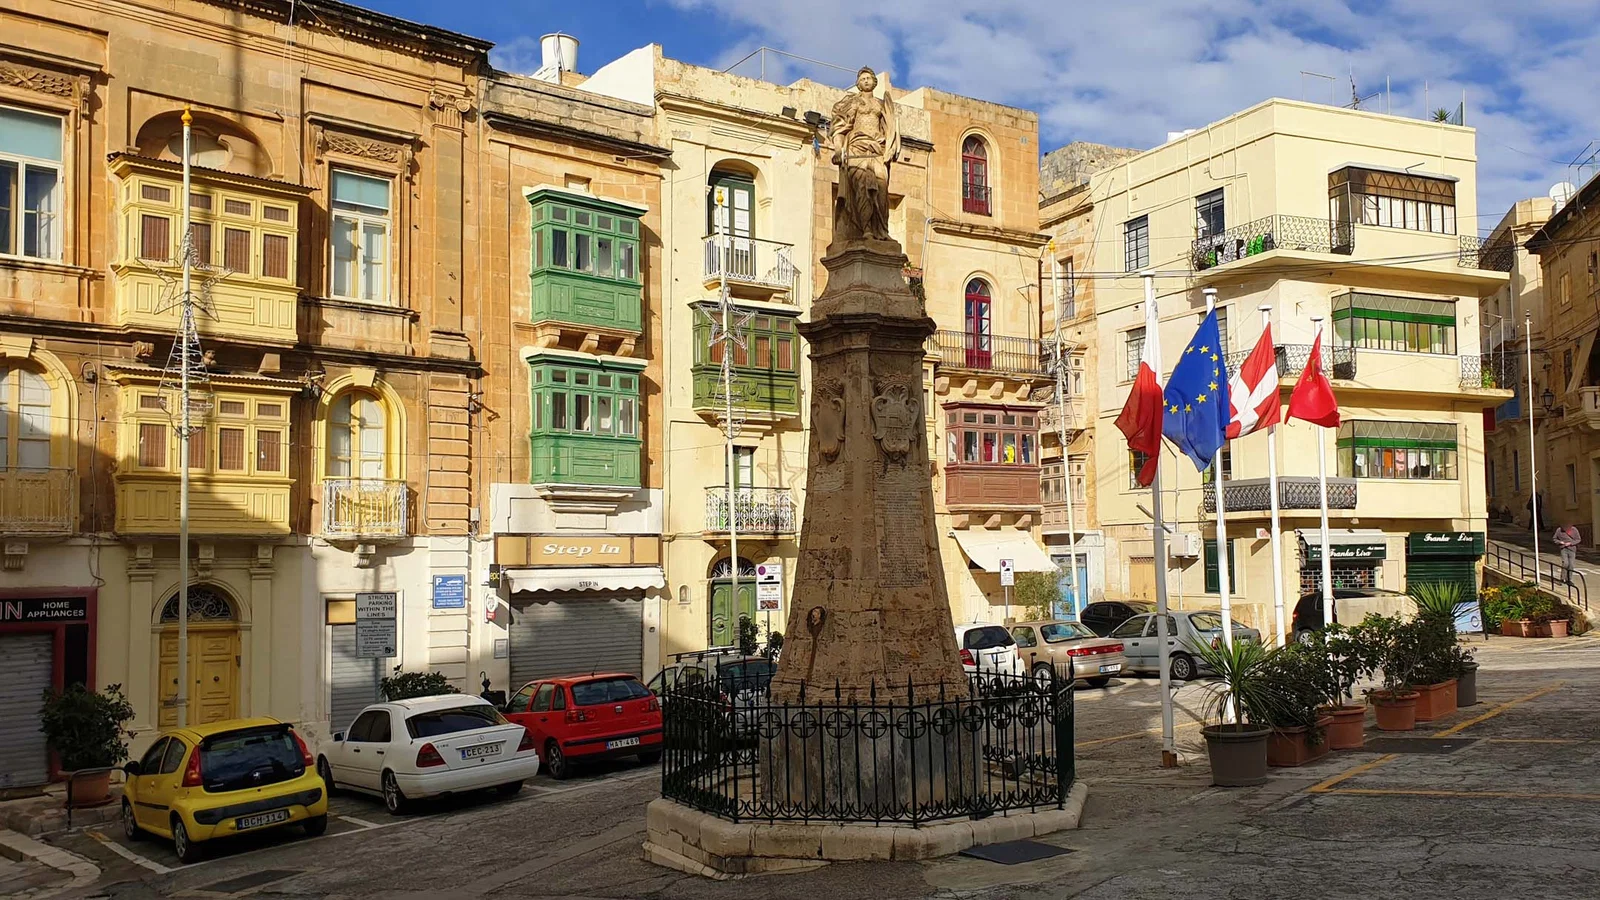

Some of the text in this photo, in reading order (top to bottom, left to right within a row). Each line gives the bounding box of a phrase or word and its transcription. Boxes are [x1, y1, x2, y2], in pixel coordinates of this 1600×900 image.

[543, 543, 620, 558] Step In
[436, 577, 443, 586] P
[43, 601, 70, 609] HOME
[27, 610, 84, 618] APPLIANCES
